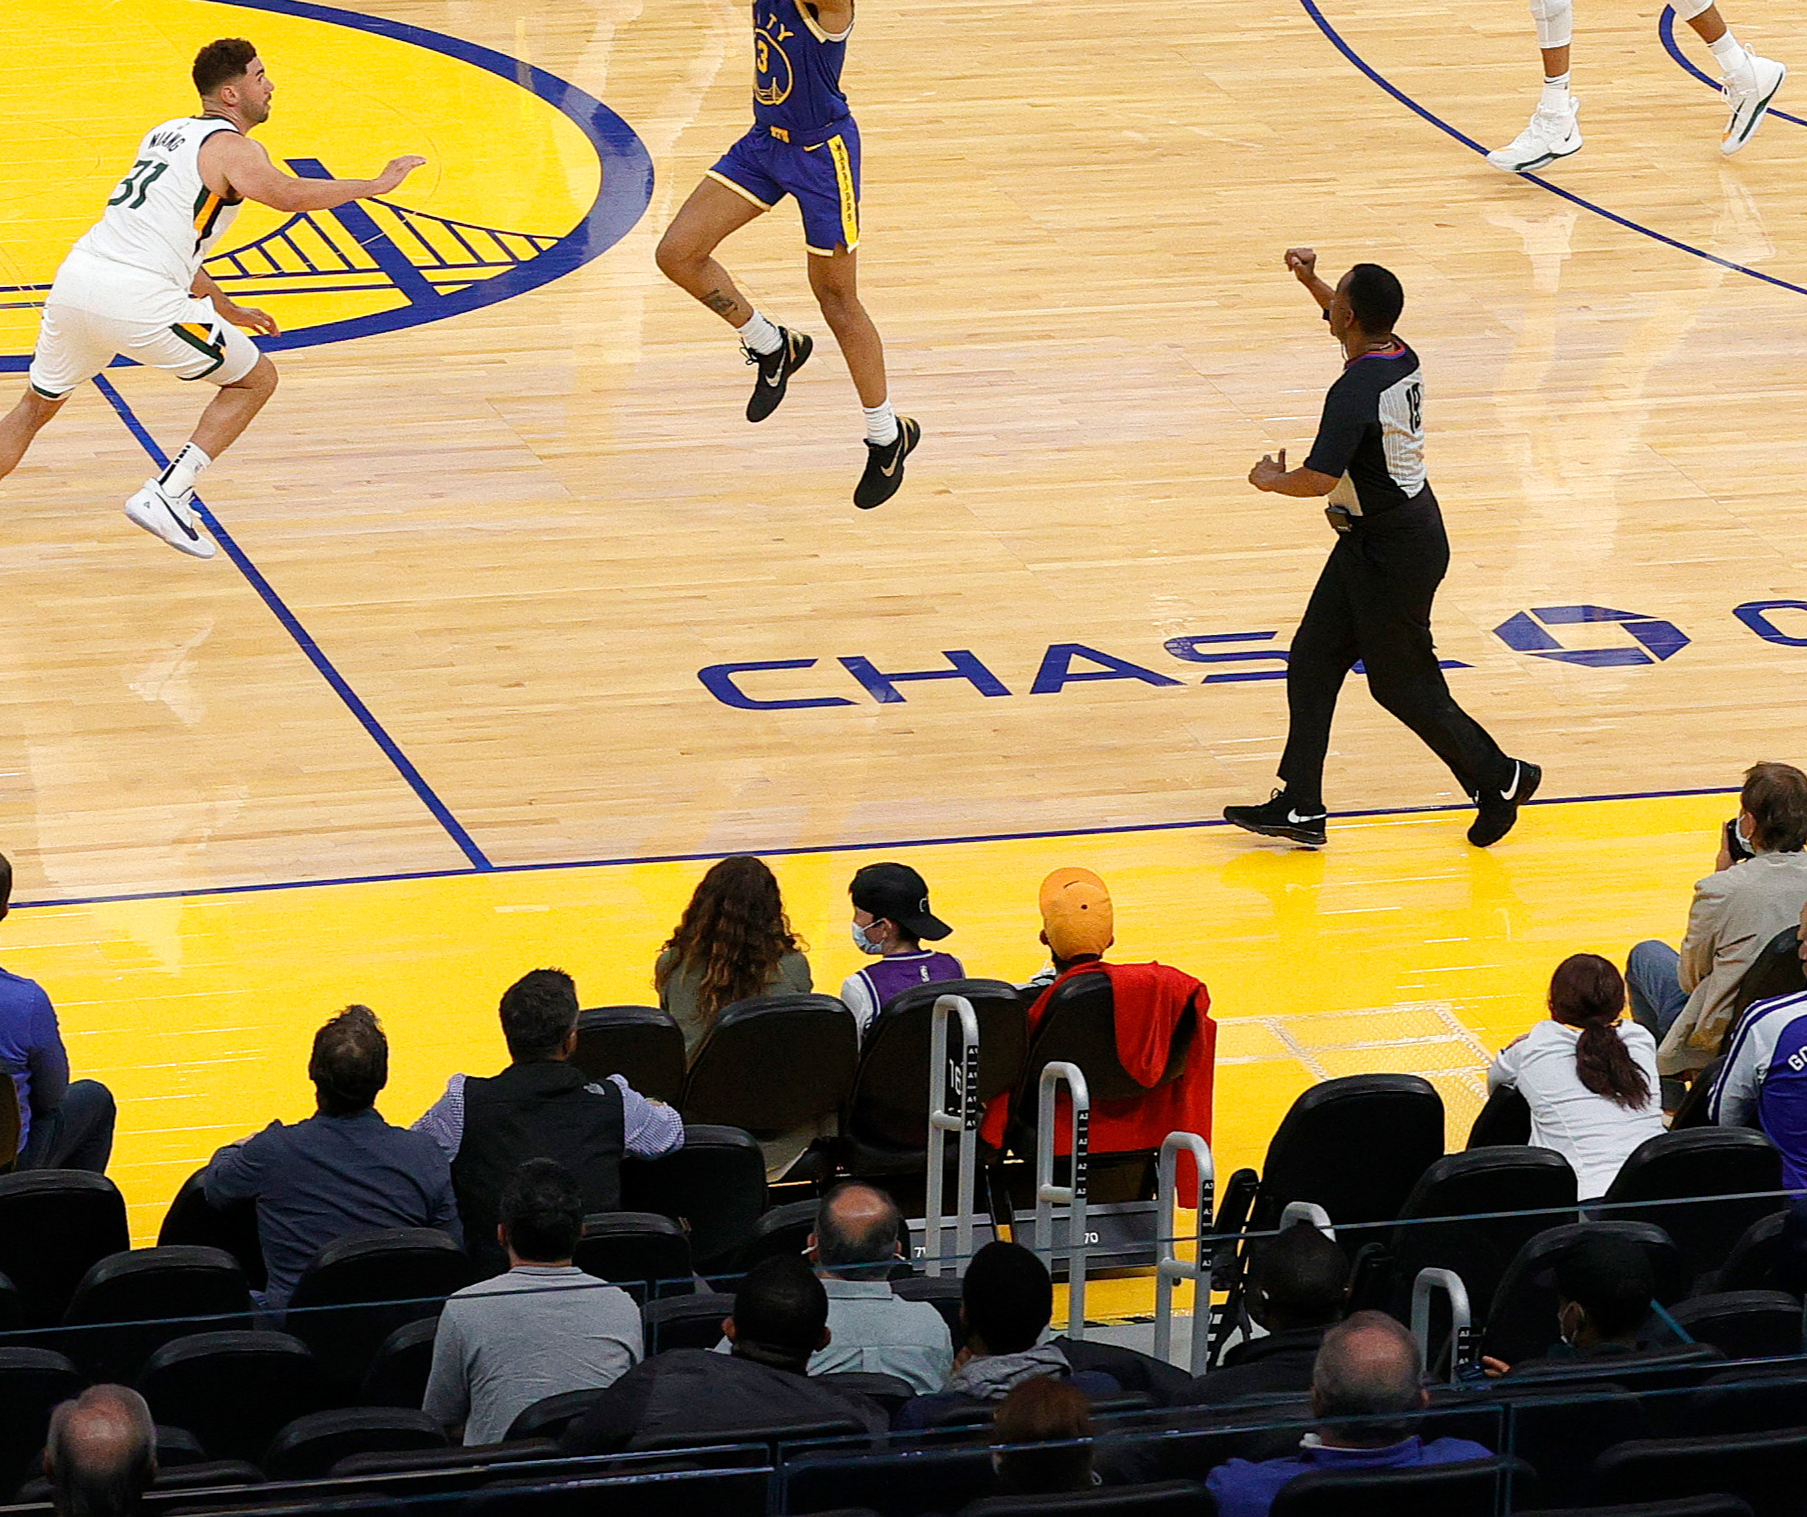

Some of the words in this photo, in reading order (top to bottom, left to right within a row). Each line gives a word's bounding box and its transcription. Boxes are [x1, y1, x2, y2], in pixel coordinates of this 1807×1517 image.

[147, 131, 187, 154] NIANG
[108, 158, 169, 210] 31
[696, 630, 1477, 711] CHAS
[1083, 1232, 1099, 1245] 70
